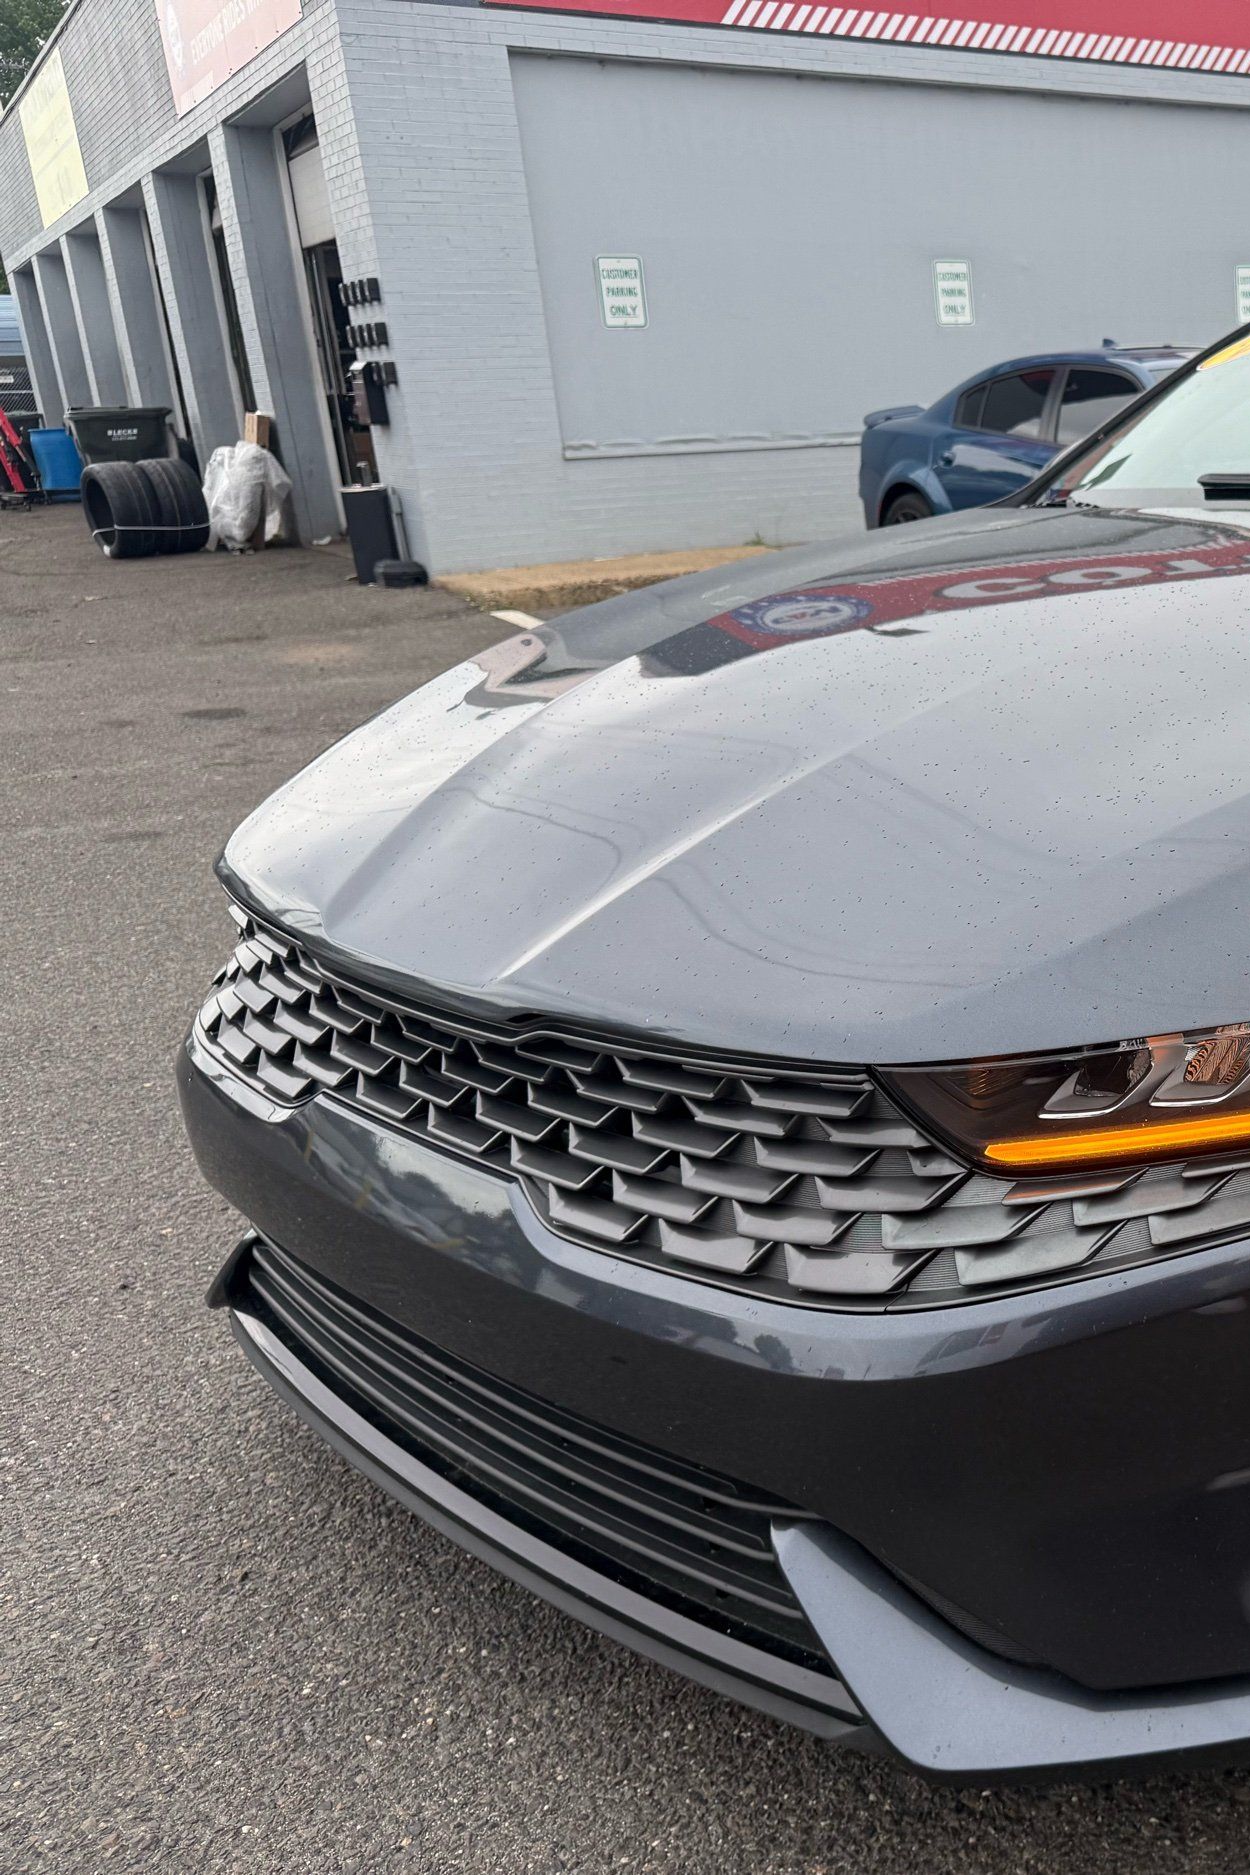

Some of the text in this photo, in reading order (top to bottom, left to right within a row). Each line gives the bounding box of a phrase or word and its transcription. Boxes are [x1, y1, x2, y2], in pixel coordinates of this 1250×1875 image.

[601, 268, 638, 279] CUSTOMER
[606, 287, 638, 297] PARKING
[610, 304, 638, 316] ONLY
